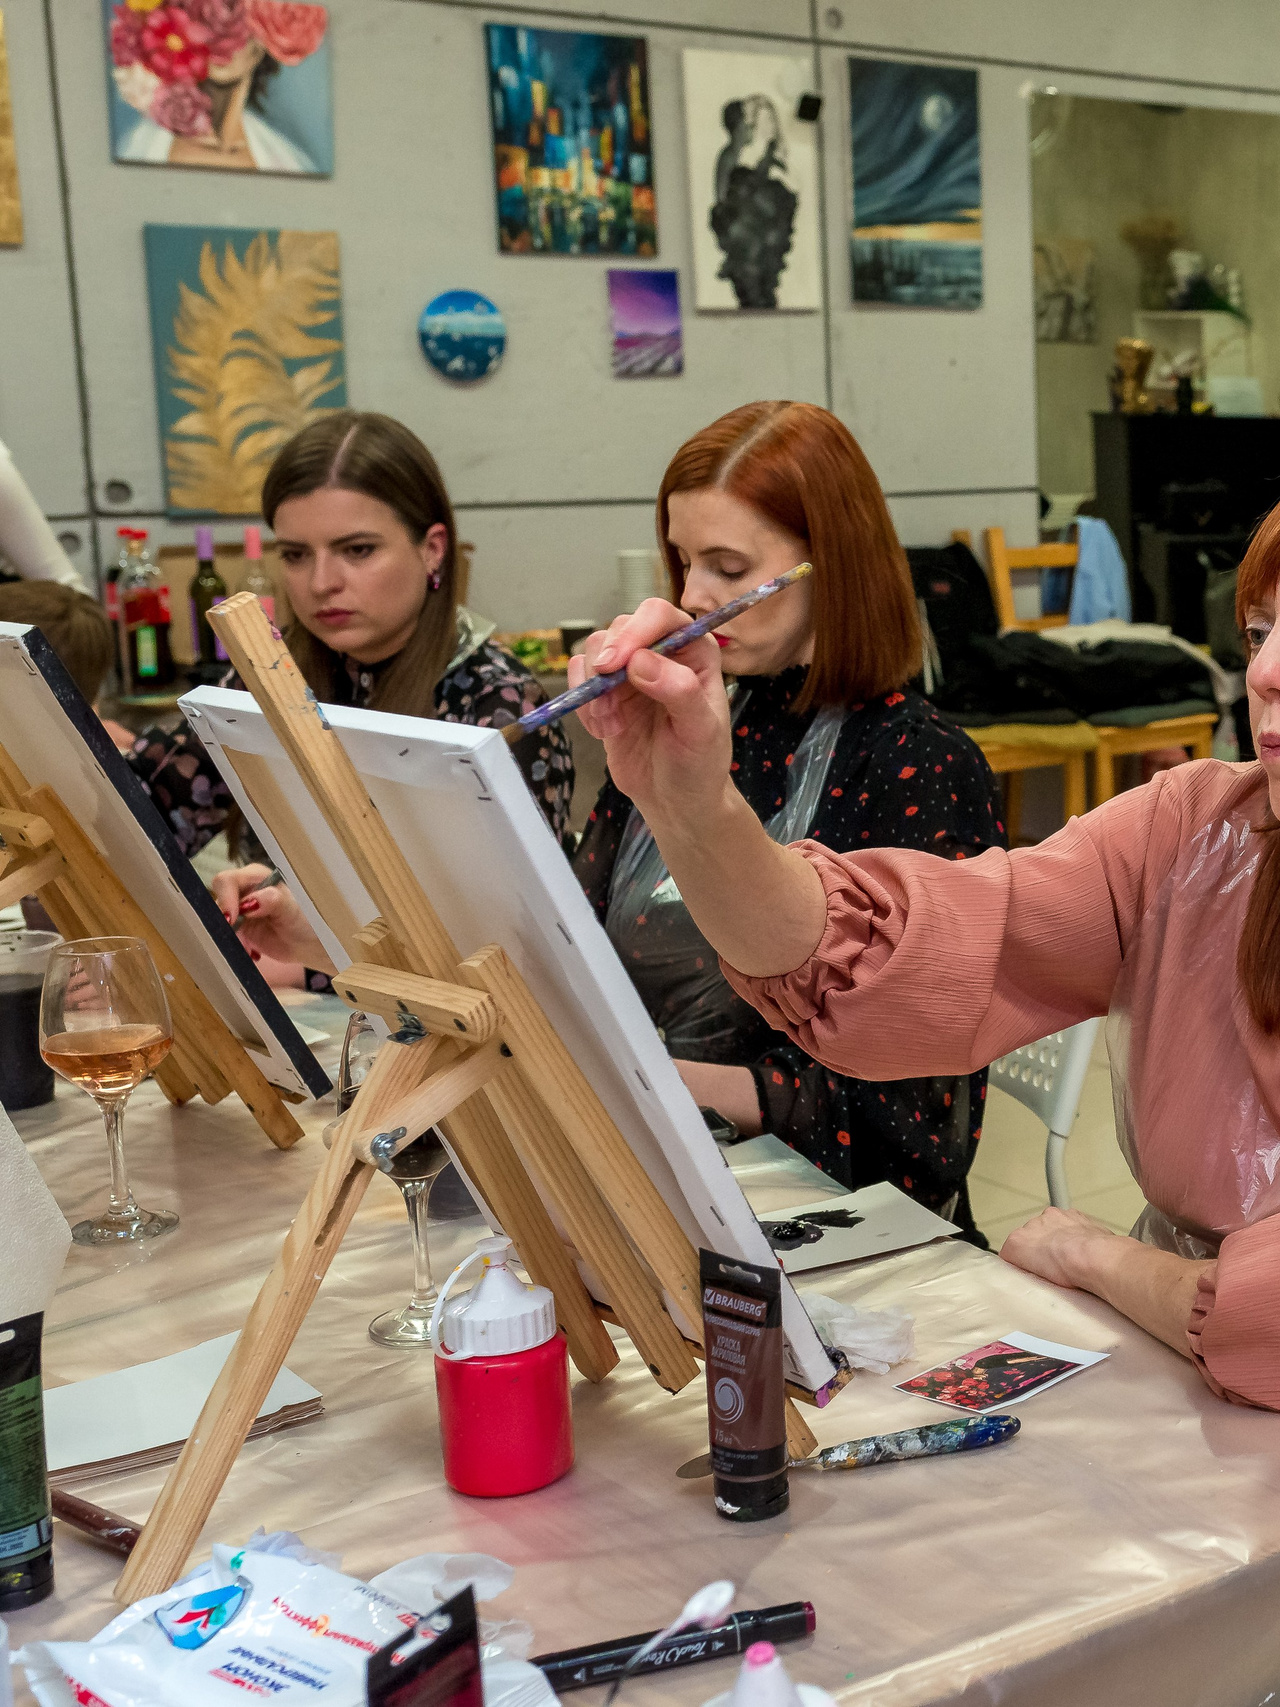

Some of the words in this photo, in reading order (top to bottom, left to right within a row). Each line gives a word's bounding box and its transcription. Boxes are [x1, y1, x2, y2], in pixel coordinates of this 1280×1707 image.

[714, 1294, 762, 1317] BRAUBERG
[716, 1334, 741, 1353] КРАСКА
[711, 1346, 746, 1366] АКРИЛОВАЯ
[715, 1428, 724, 1442] 75
[220, 1661, 291, 1693] ЭКОНОМ
[228, 1646, 329, 1691] УНИВЕРСАЛЬНЫЕ
